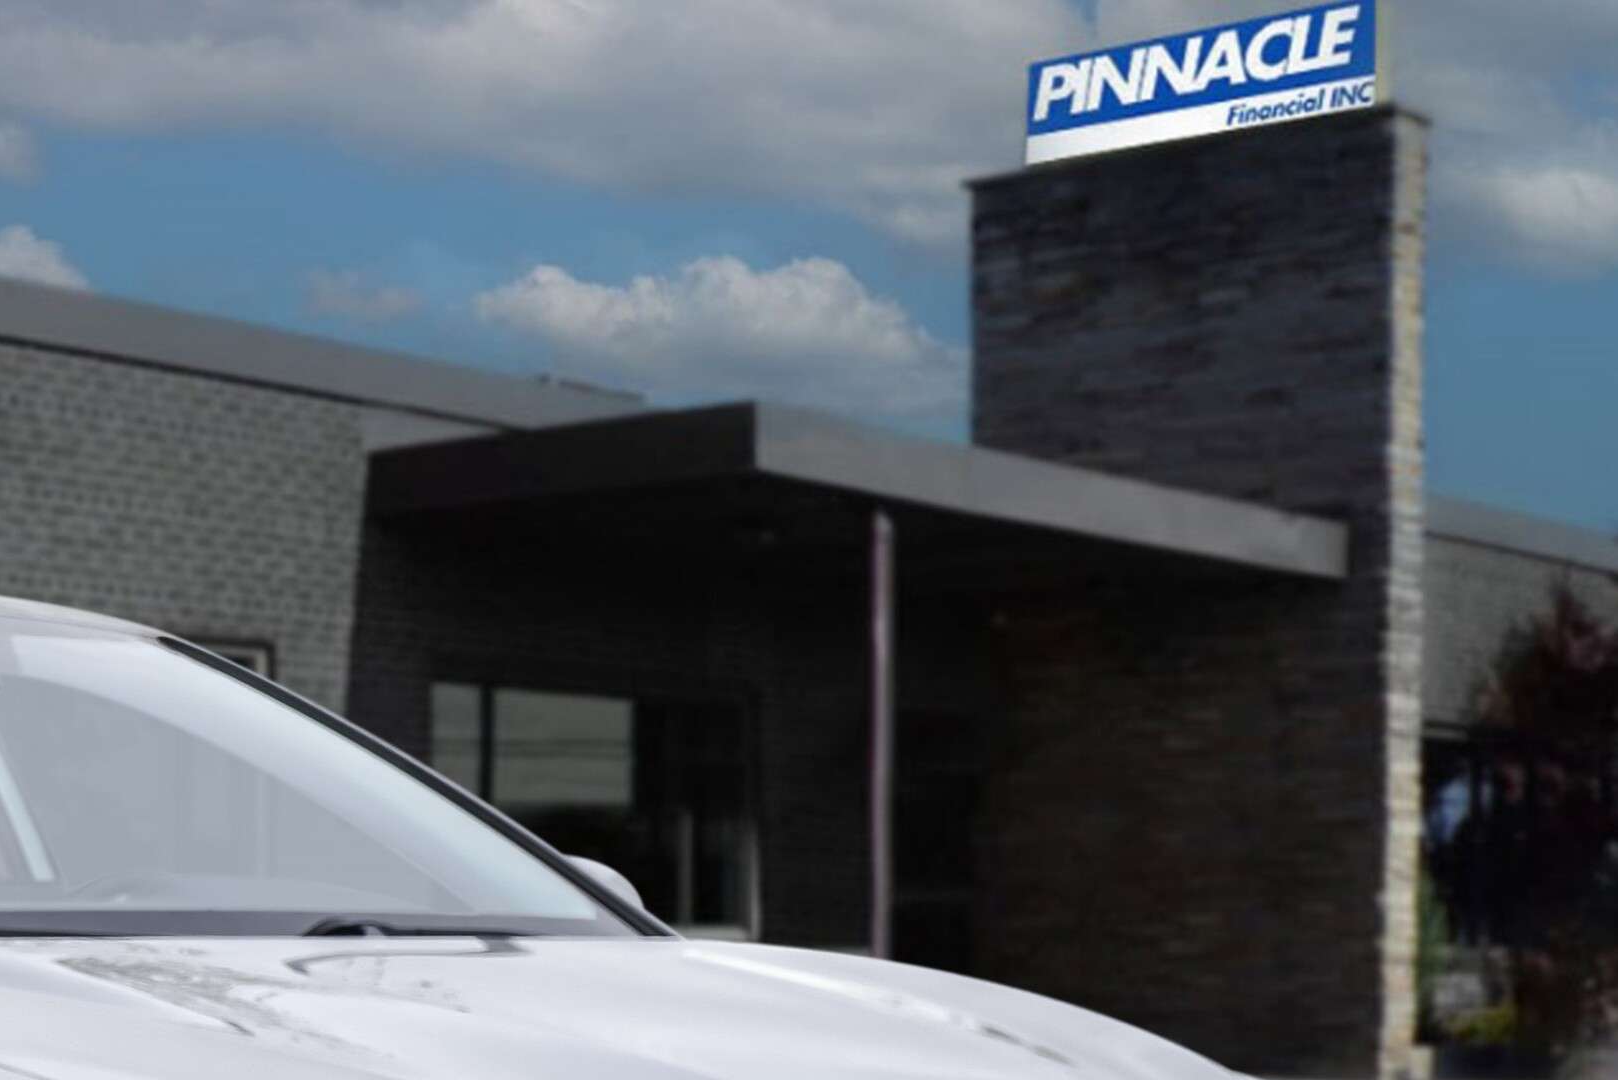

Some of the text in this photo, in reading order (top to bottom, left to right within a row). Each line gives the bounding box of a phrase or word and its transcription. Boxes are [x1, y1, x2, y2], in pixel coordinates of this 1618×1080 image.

[1033, 4, 1360, 123] PINNACLE
[1226, 81, 1375, 127] Financial INC
